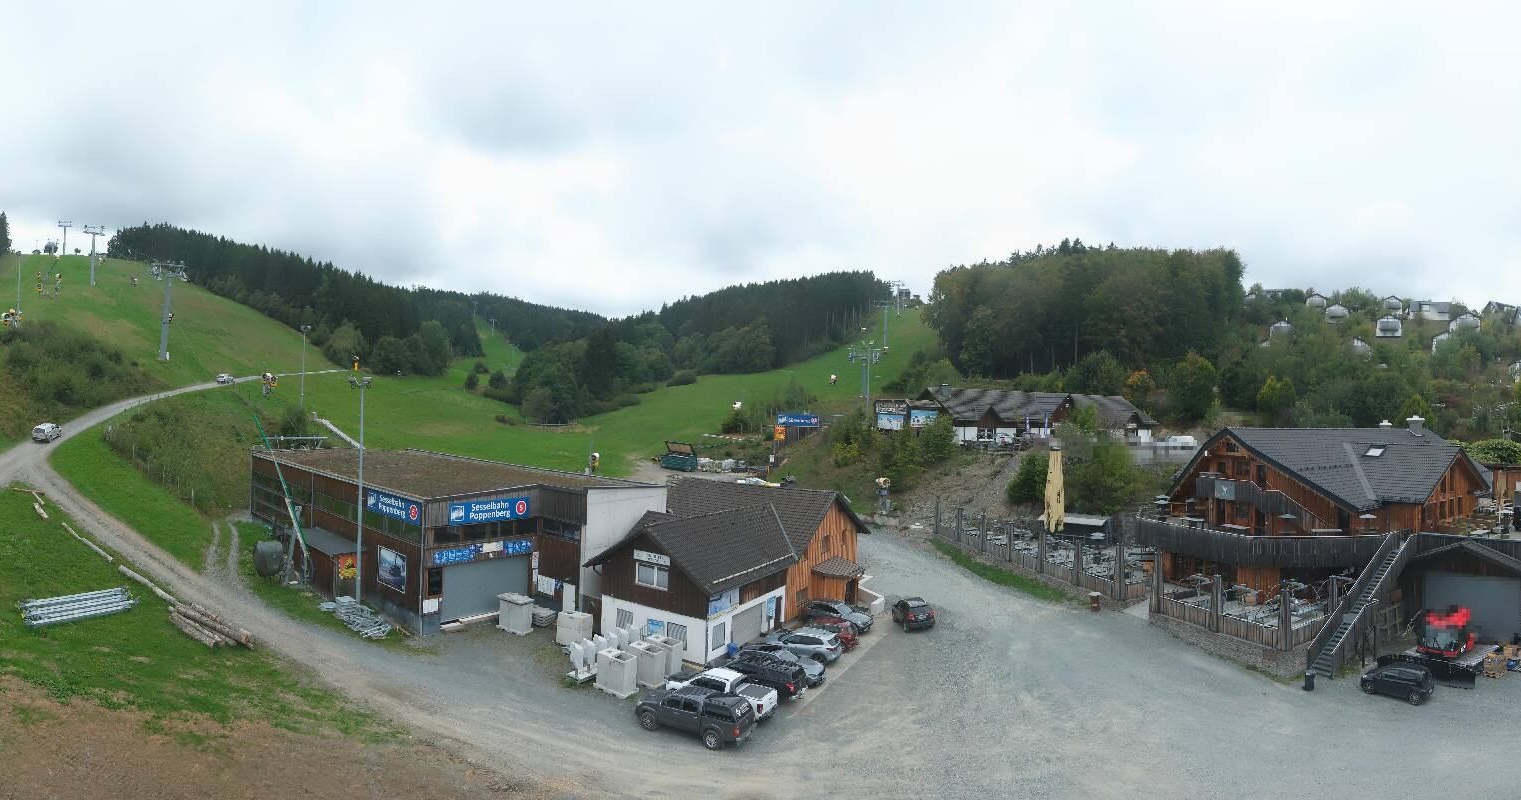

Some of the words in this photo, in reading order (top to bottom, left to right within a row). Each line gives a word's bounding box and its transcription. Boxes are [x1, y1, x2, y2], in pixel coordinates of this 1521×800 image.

[379, 494, 405, 508] Sesselbahn
[471, 501, 509, 511] Sesselbahn
[469, 510, 511, 521] Poppenberg
